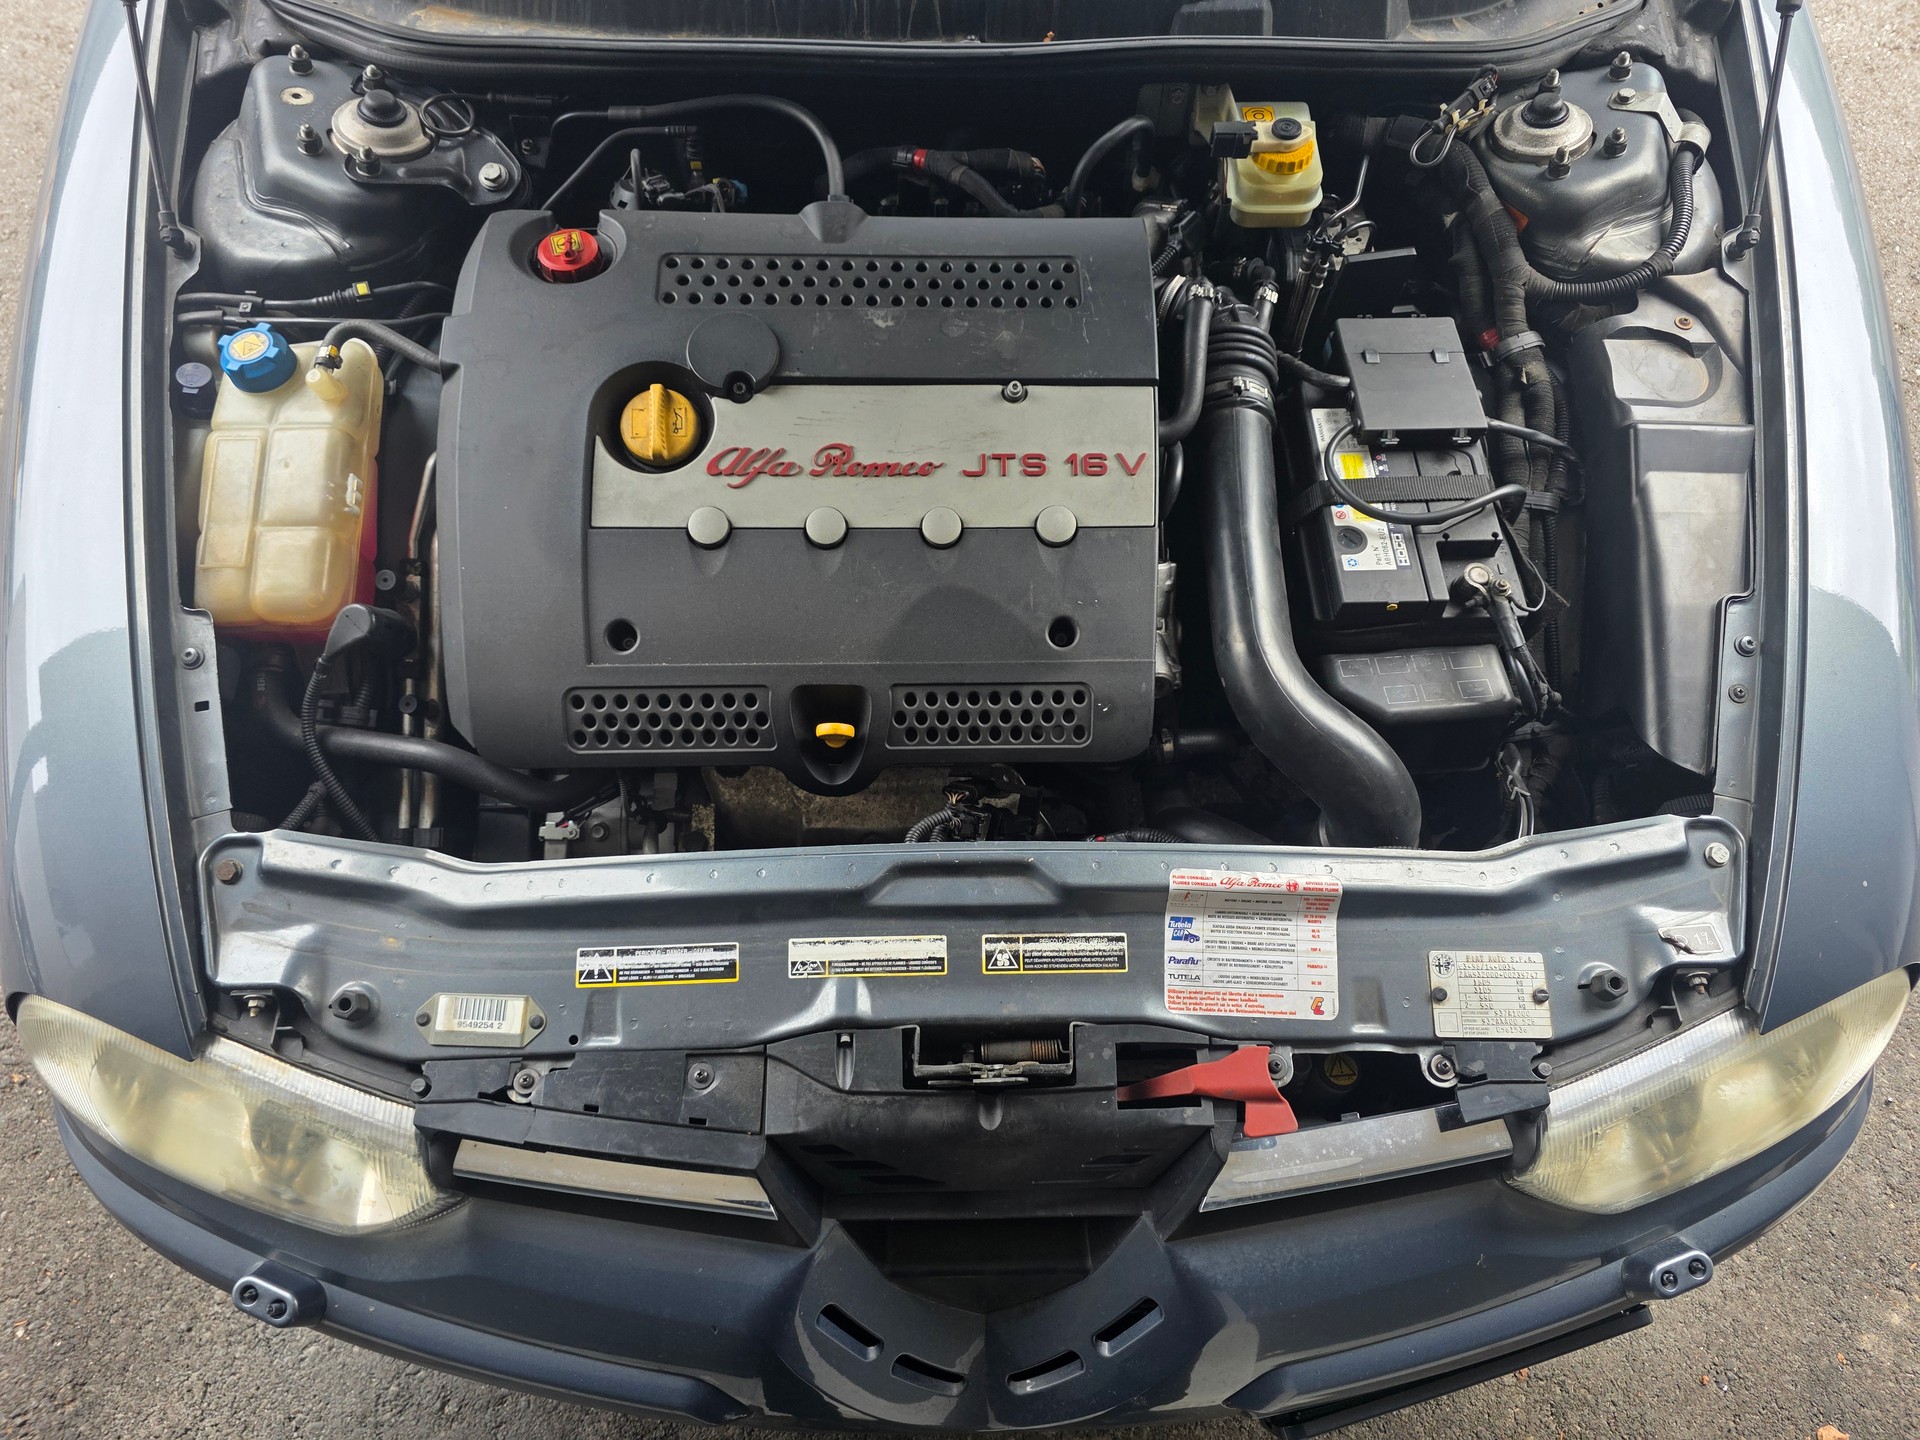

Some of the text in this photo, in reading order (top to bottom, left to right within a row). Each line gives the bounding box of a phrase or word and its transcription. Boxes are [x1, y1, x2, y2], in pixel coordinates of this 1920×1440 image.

[706, 446, 801, 488] Alfa
[808, 443, 945, 477] Romeo
[961, 453, 1047, 477] JTS
